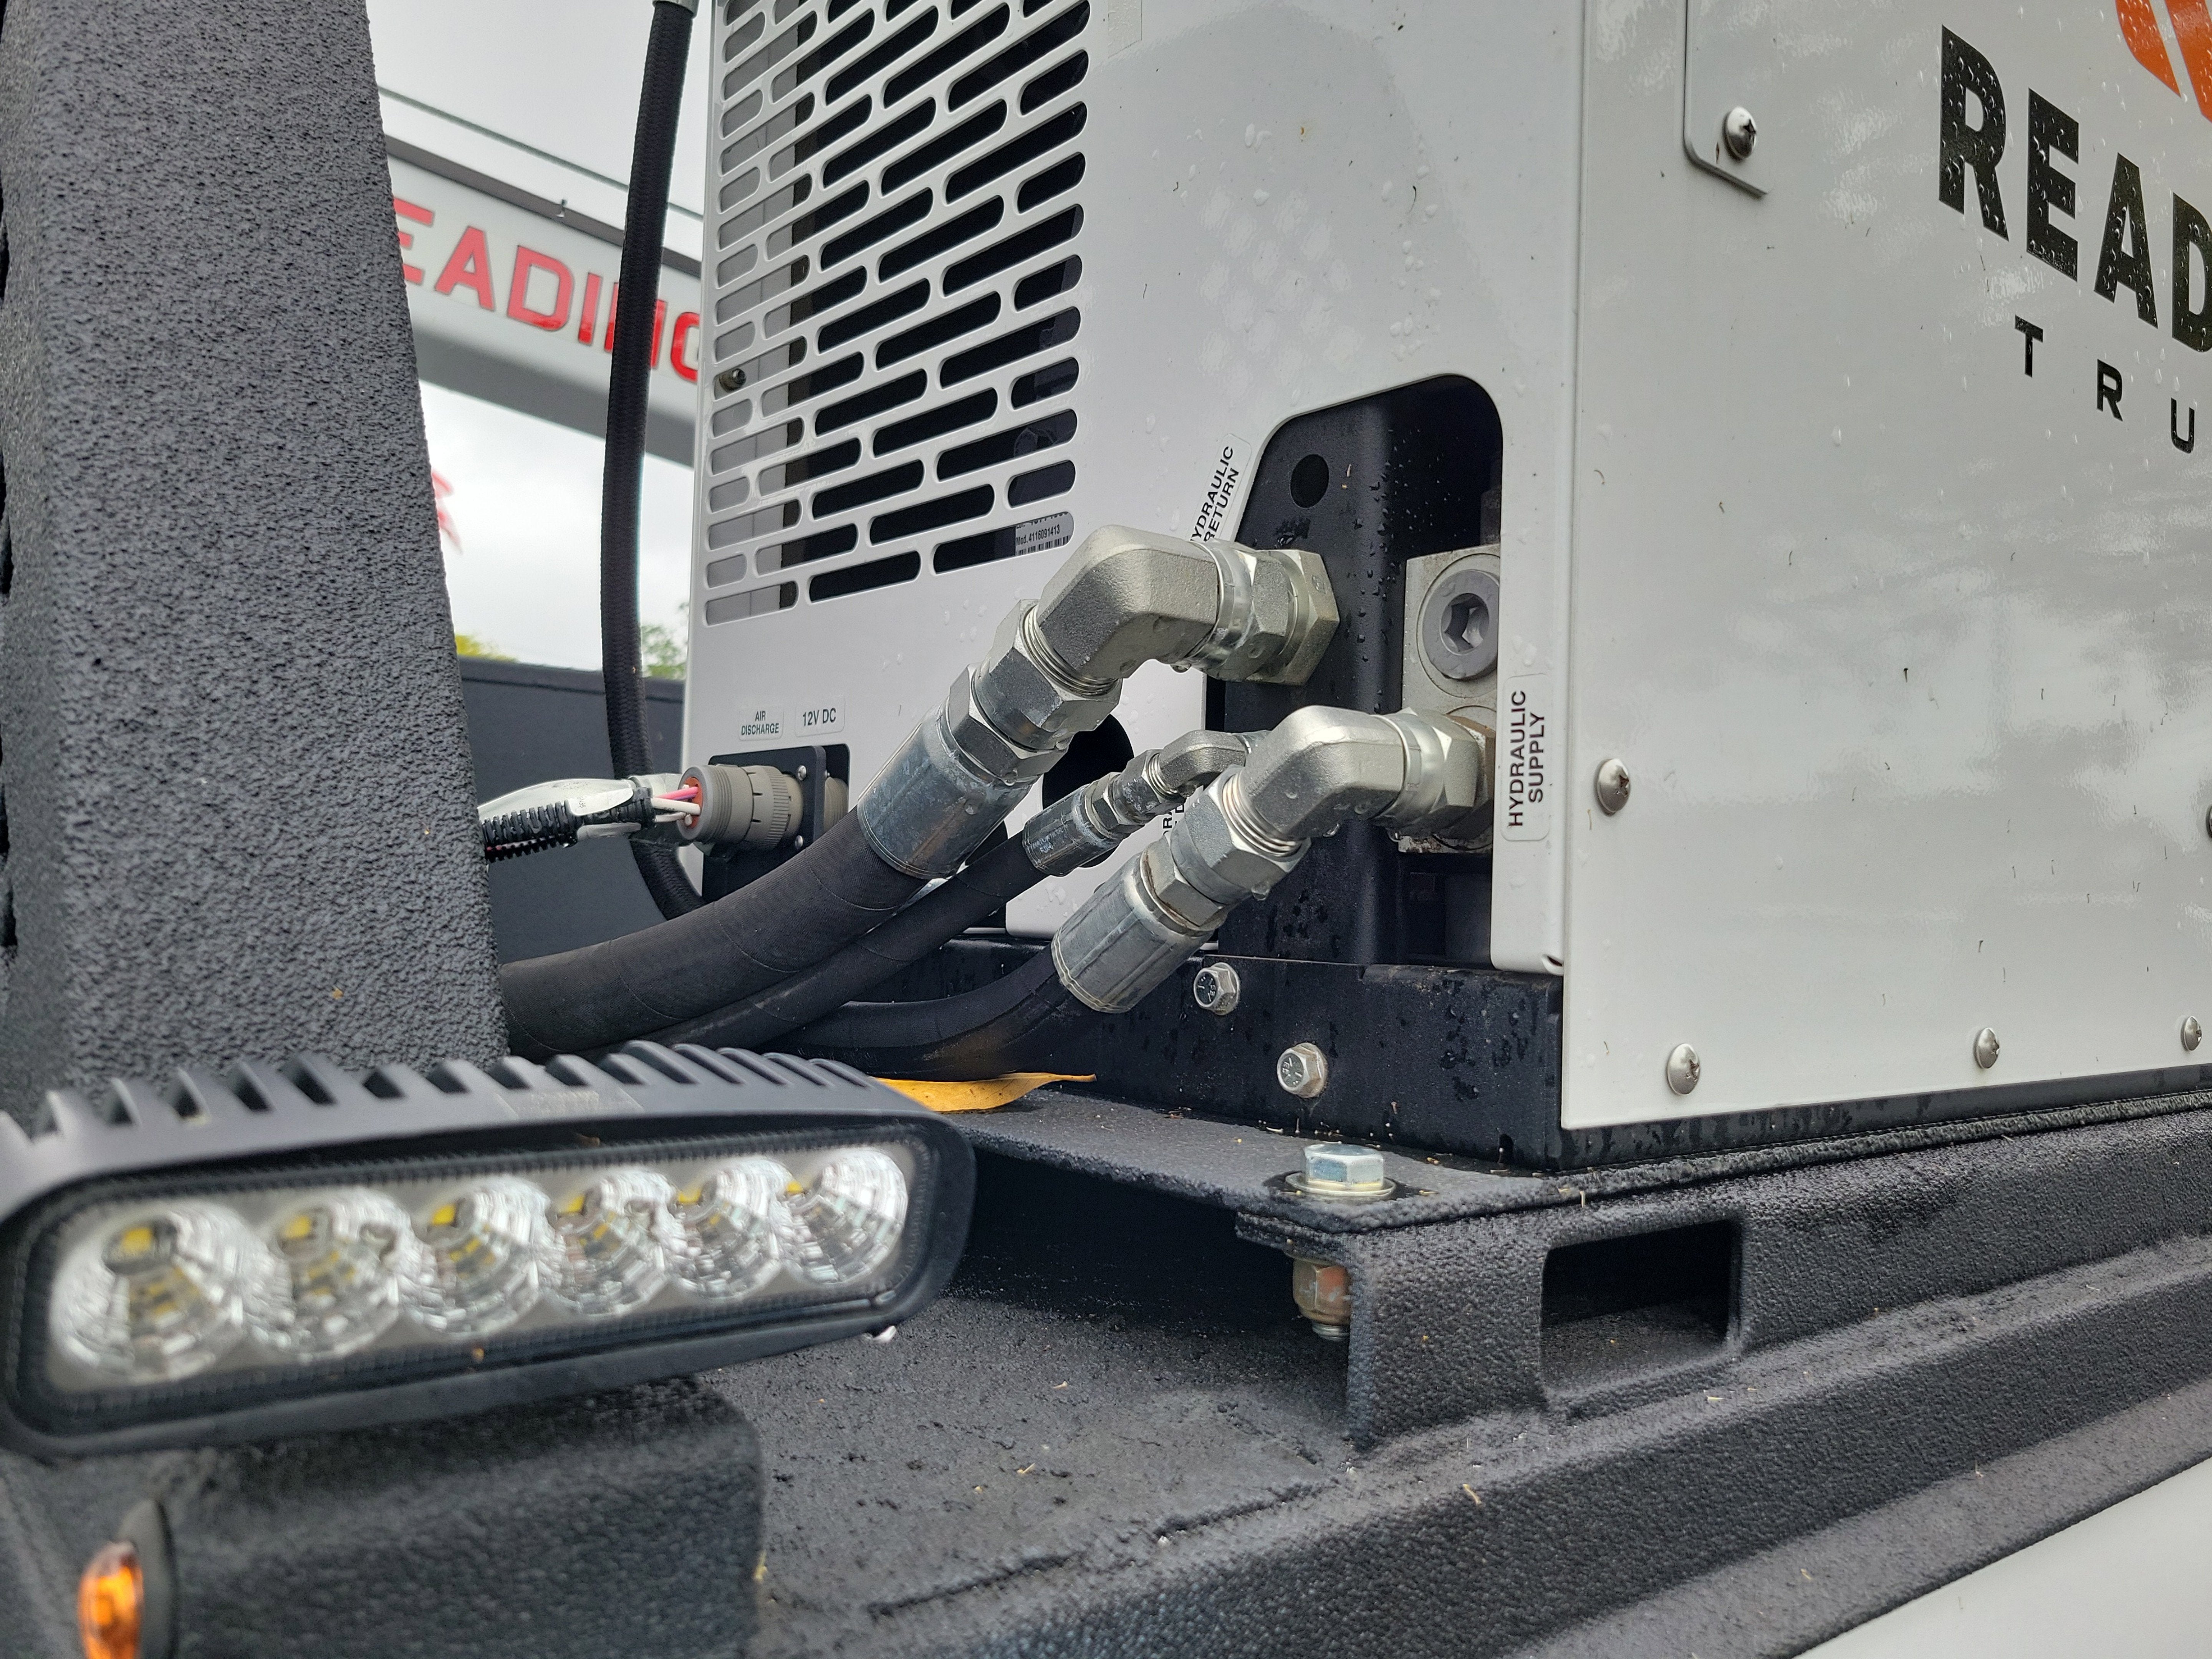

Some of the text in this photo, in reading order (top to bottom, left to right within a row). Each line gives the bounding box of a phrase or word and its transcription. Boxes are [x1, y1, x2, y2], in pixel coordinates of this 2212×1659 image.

[2015, 315, 2195, 454] TRU
[1190, 446, 1233, 541] YDRAULIC
[741, 723, 779, 736] DISCHARGE
[755, 710, 766, 722] AIR
[803, 707, 836, 727] 12V DC
[1508, 690, 1526, 826] HYDRAULIC
[1528, 712, 1545, 803] SUPPLY
